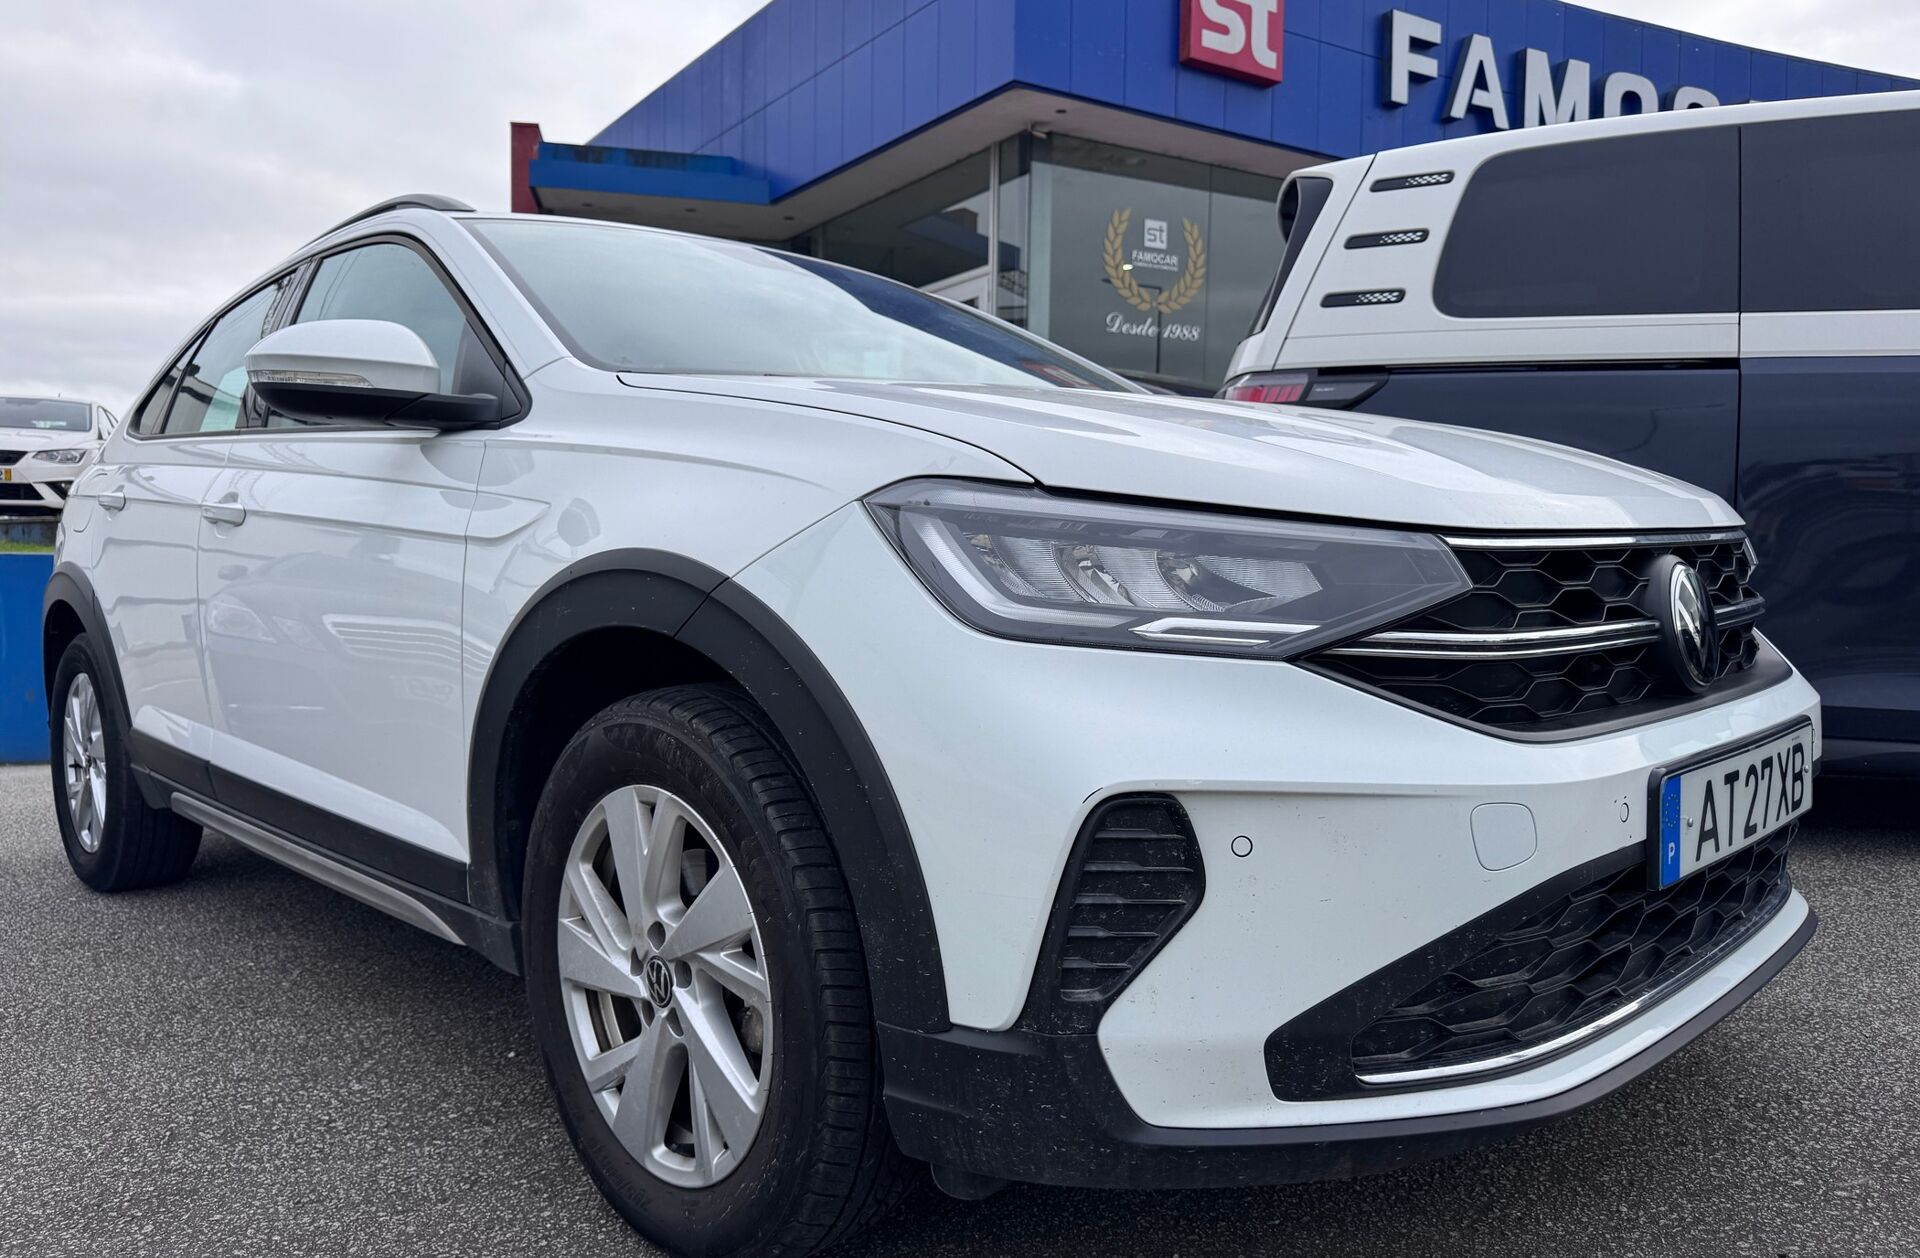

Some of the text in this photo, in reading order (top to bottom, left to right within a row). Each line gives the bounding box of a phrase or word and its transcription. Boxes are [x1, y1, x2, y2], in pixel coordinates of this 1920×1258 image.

[1147, 224, 1164, 244] st
[1132, 250, 1179, 267] FAMOCAR
[1106, 312, 1201, 341] Desde 1988
[1668, 842, 1676, 865] P
